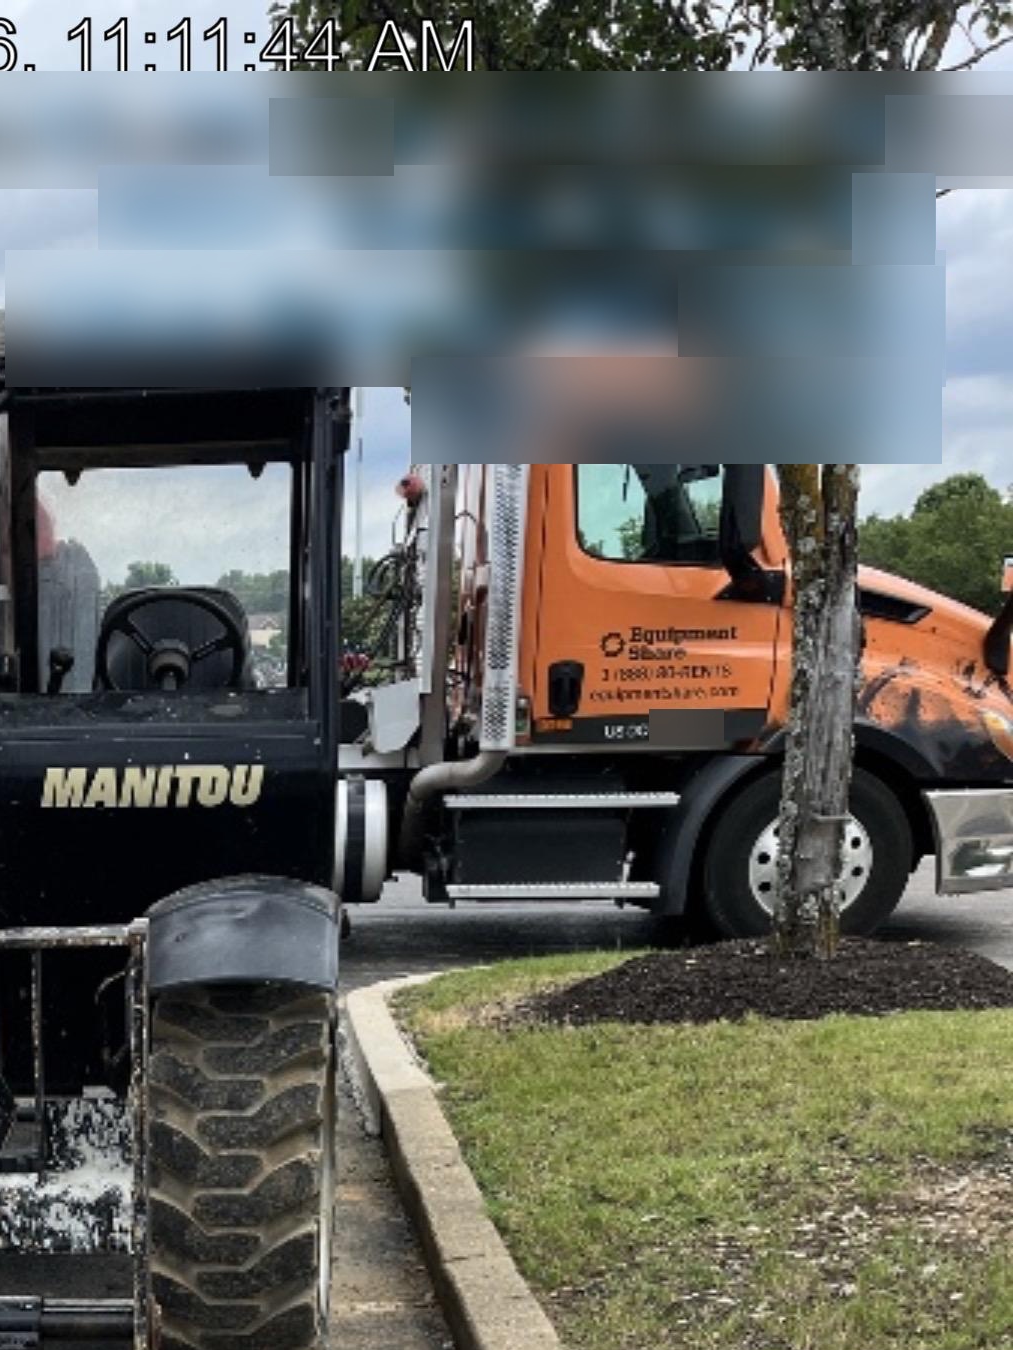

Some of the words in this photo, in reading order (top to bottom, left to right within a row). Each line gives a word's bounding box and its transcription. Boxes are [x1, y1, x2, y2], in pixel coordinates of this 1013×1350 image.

[629, 626, 738, 645] Equipment
[628, 645, 687, 661] Share
[40, 764, 265, 808] MANITOU
